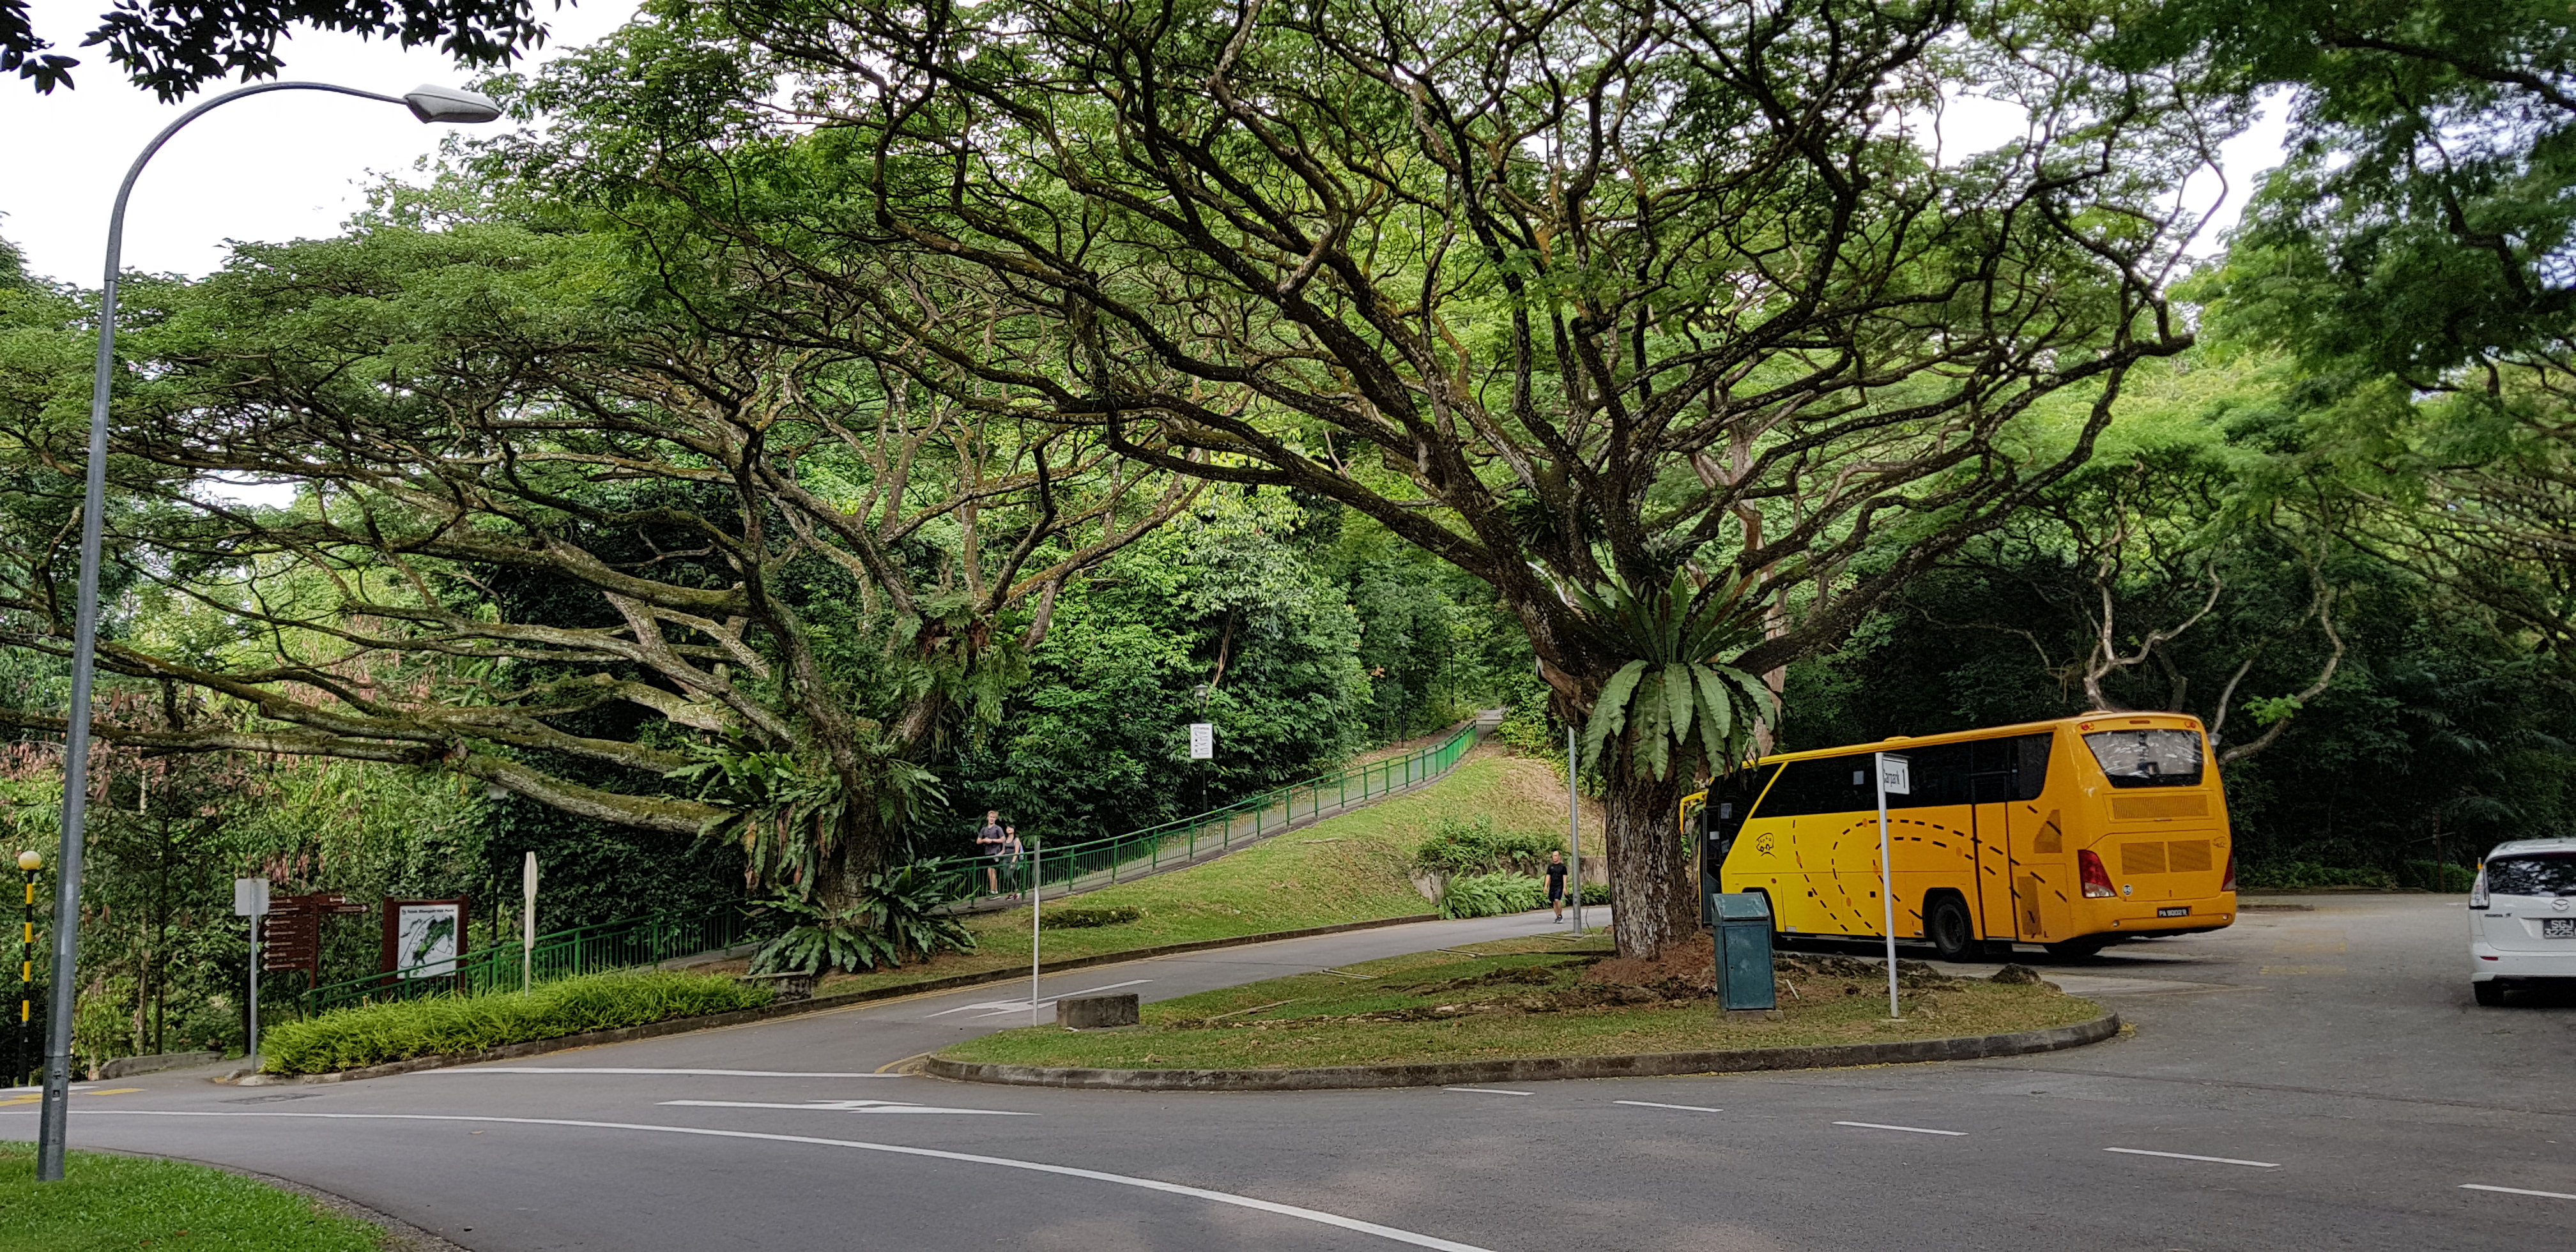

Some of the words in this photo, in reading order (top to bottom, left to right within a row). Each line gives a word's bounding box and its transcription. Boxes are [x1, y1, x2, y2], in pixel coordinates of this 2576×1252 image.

[1902, 768, 1906, 789] 1
[2551, 920, 2573, 928] SGJ
[2545, 928, 2576, 937] 3225
